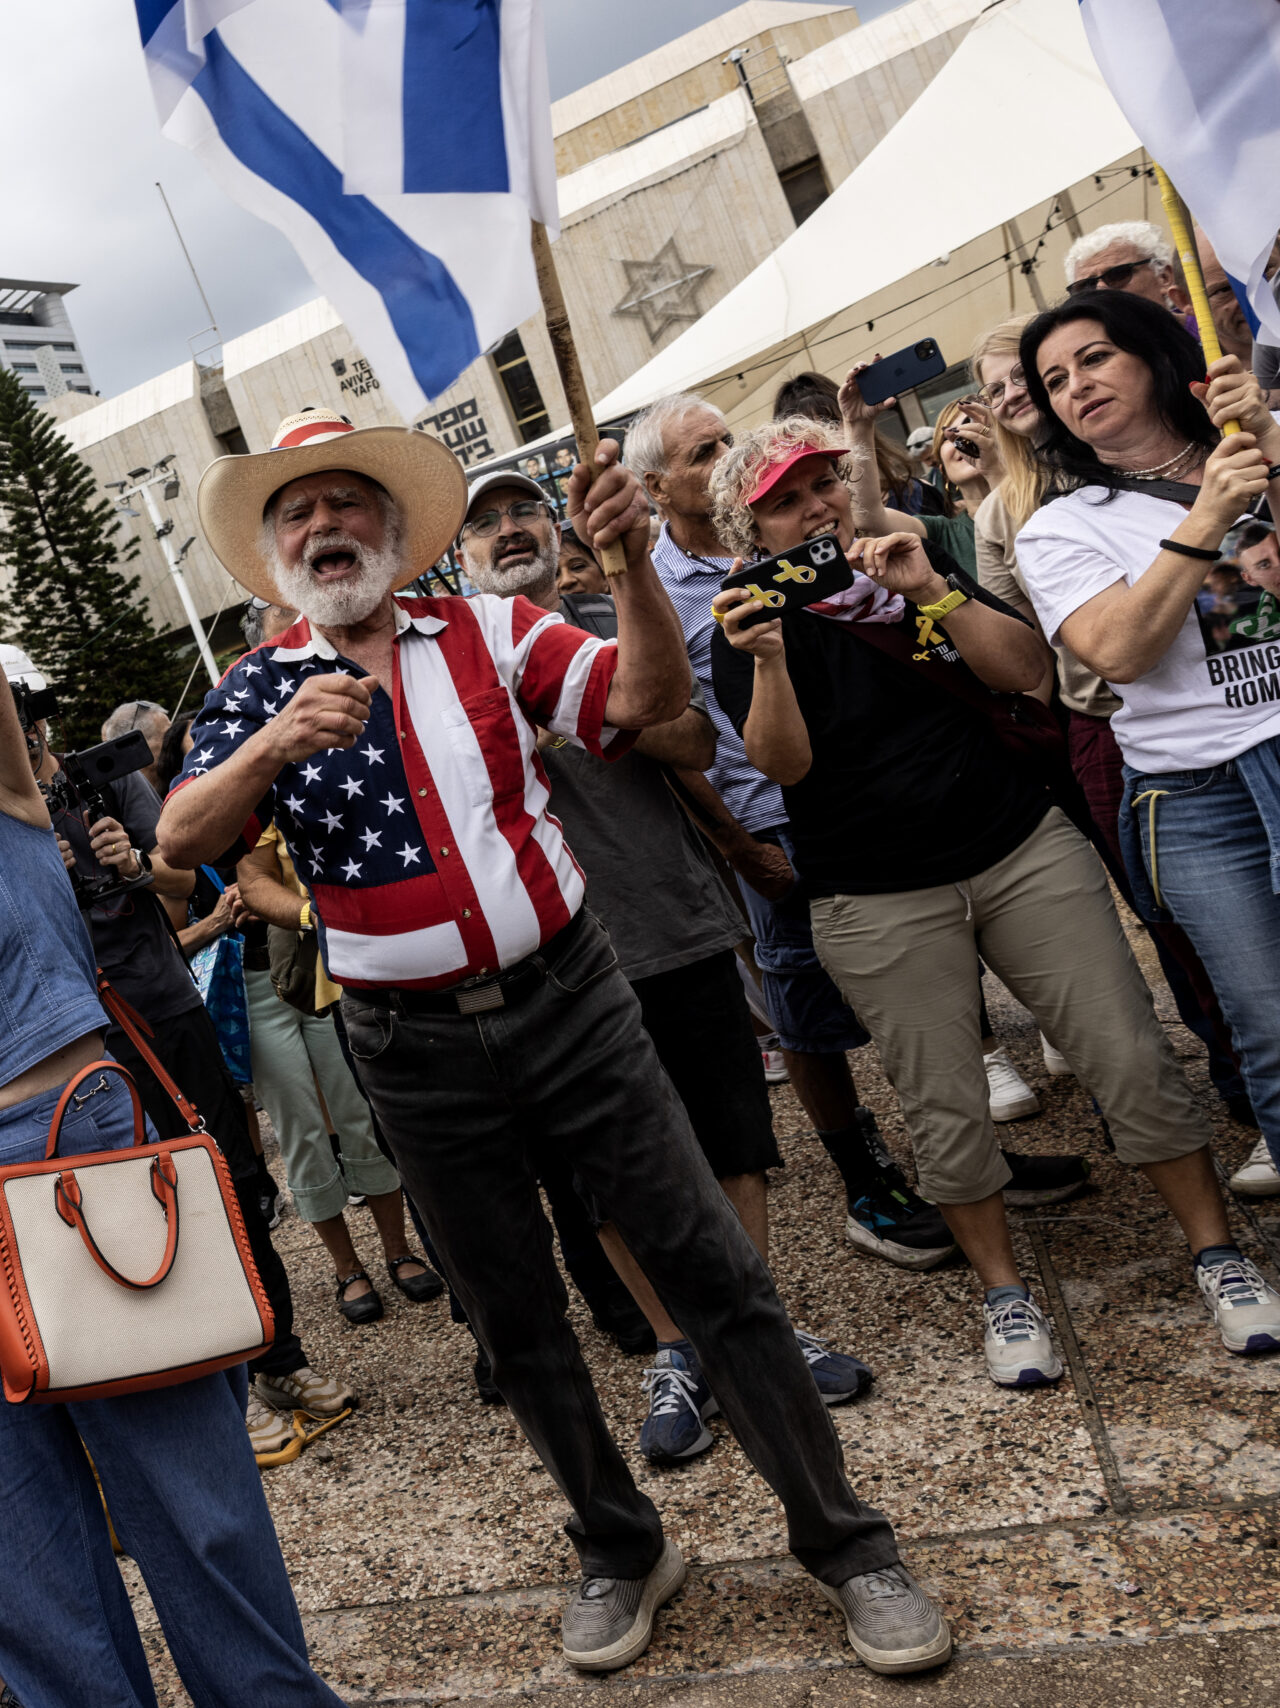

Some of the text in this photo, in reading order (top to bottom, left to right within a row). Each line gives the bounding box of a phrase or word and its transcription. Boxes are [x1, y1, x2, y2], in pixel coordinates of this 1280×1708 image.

[352, 379, 380, 398] YAFO
[414, 397, 479, 433] ספרי
[436, 417, 488, 449] שע
[1206, 645, 1280, 686] BRING
[1225, 672, 1280, 708] HOM
